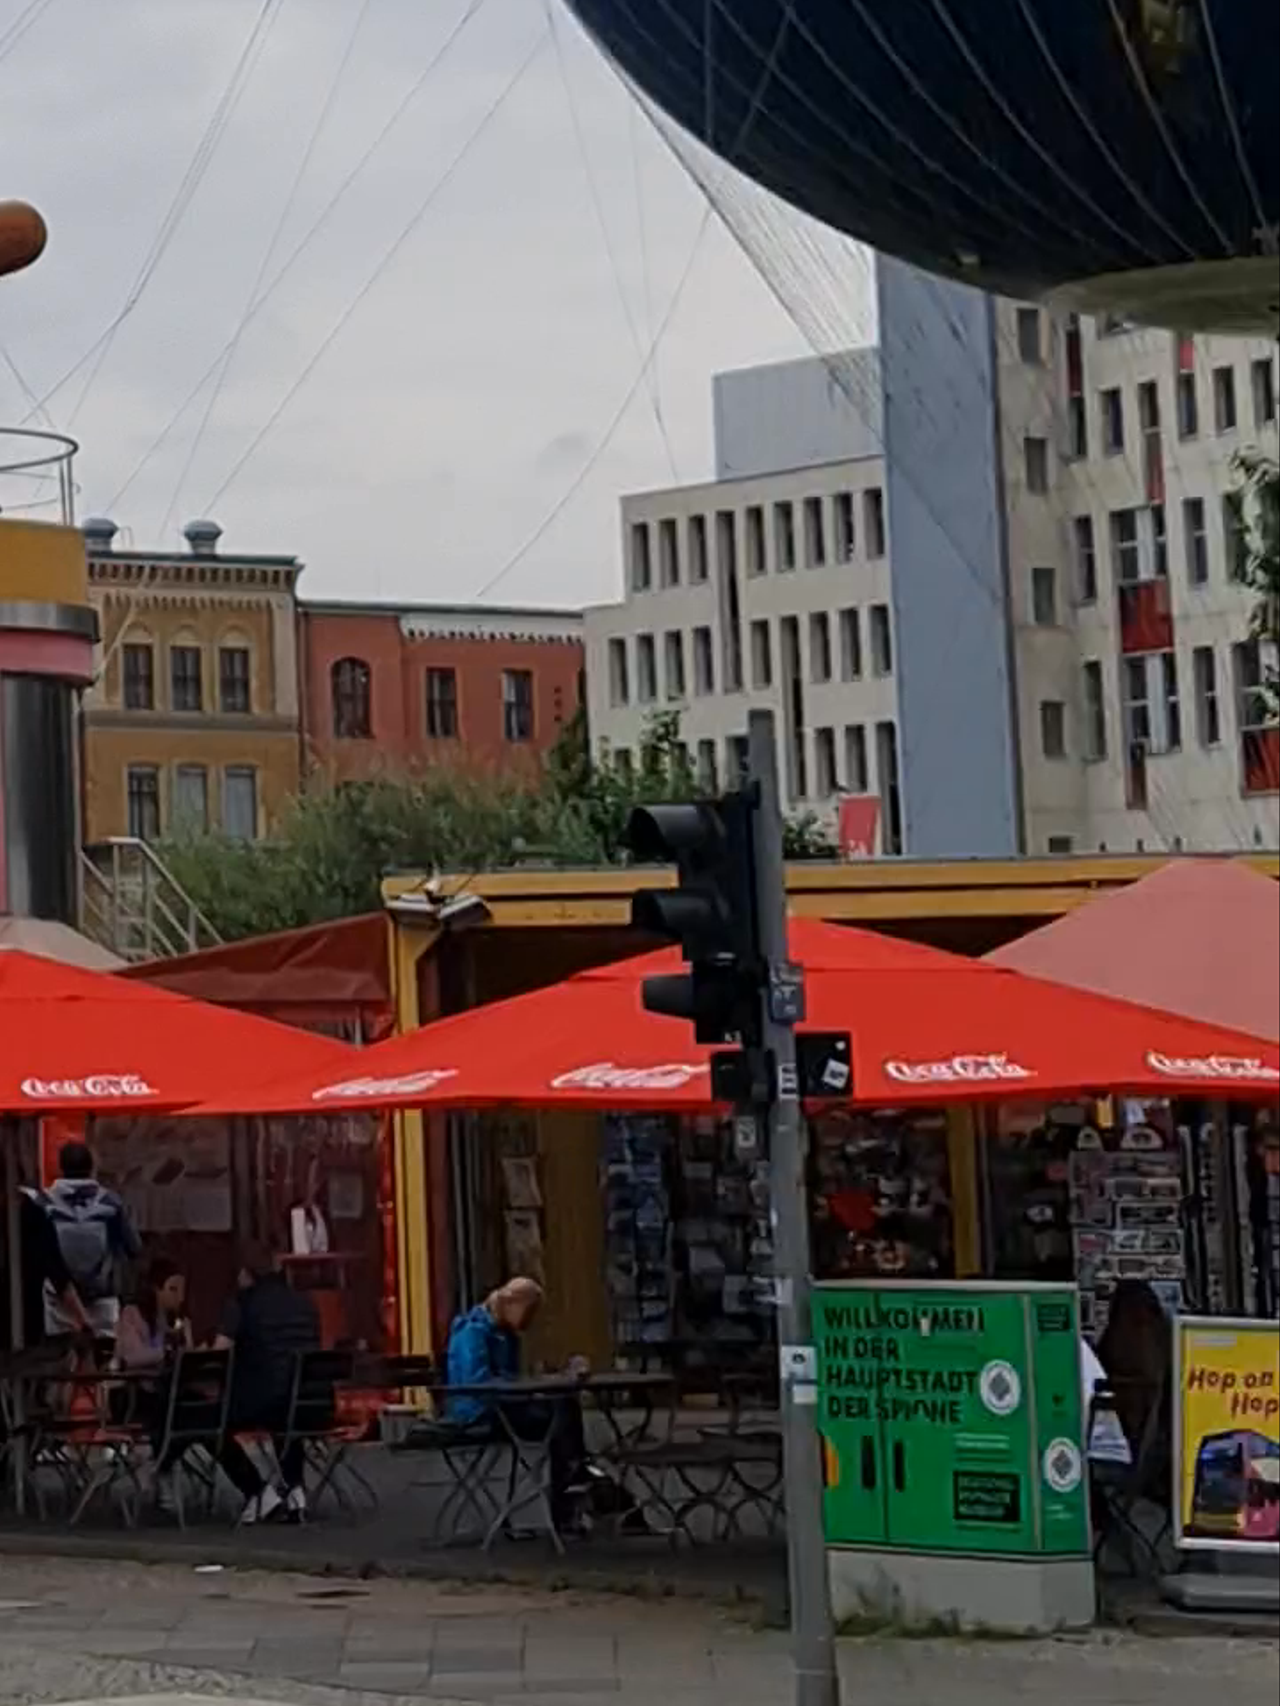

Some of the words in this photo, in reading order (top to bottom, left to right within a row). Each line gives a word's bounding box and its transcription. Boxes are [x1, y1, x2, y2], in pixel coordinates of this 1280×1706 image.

[824, 1307, 985, 1331] WILLKOMMEN
[825, 1337, 848, 1358] IN
[854, 1338, 899, 1361] DER
[826, 1365, 979, 1393] HAUPTSTADT
[1187, 1366, 1236, 1393] Hop
[827, 1396, 871, 1421] DER
[876, 1398, 963, 1424] SPIONE
[1230, 1392, 1279, 1420] Hop
